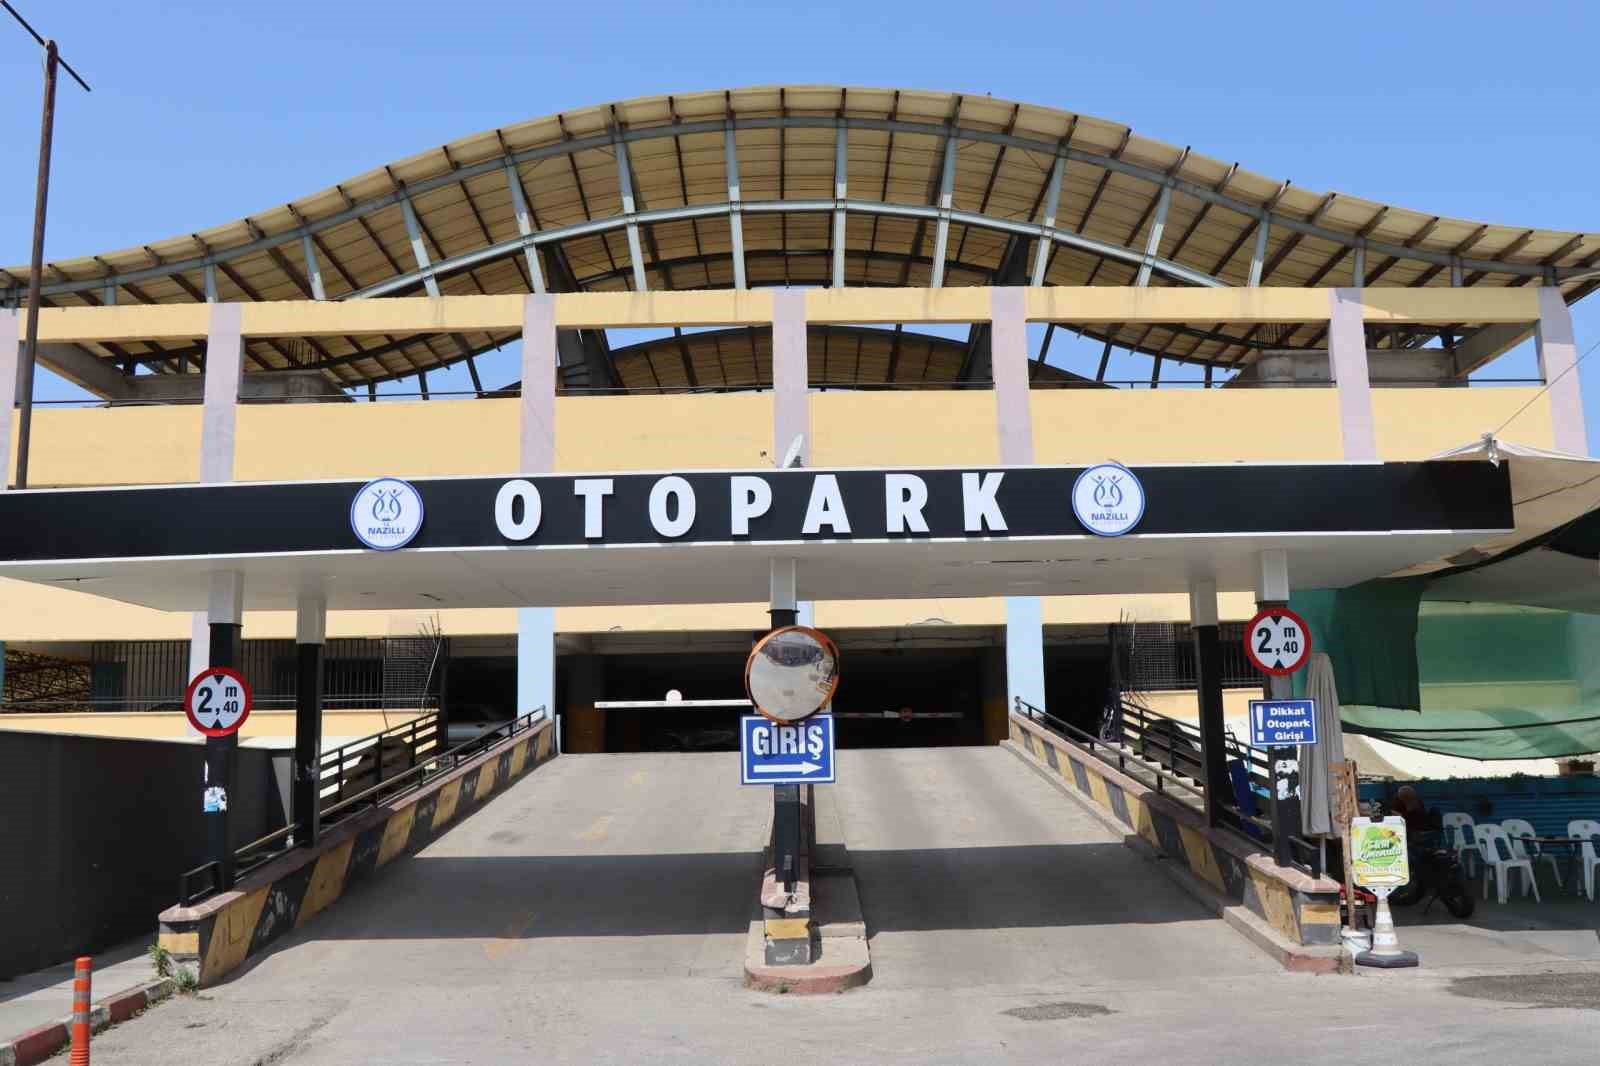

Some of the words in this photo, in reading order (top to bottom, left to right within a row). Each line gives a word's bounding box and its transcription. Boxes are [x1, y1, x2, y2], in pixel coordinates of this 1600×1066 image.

[495, 473, 1008, 540] OTOPARK
[1283, 627, 1296, 638] m
[225, 686, 238, 697] m
[1270, 707, 1306, 716] Dikkat
[1266, 719, 1311, 729] Otopark
[752, 721, 824, 760] GİRİŞ
[1274, 731, 1305, 742] Girişi
